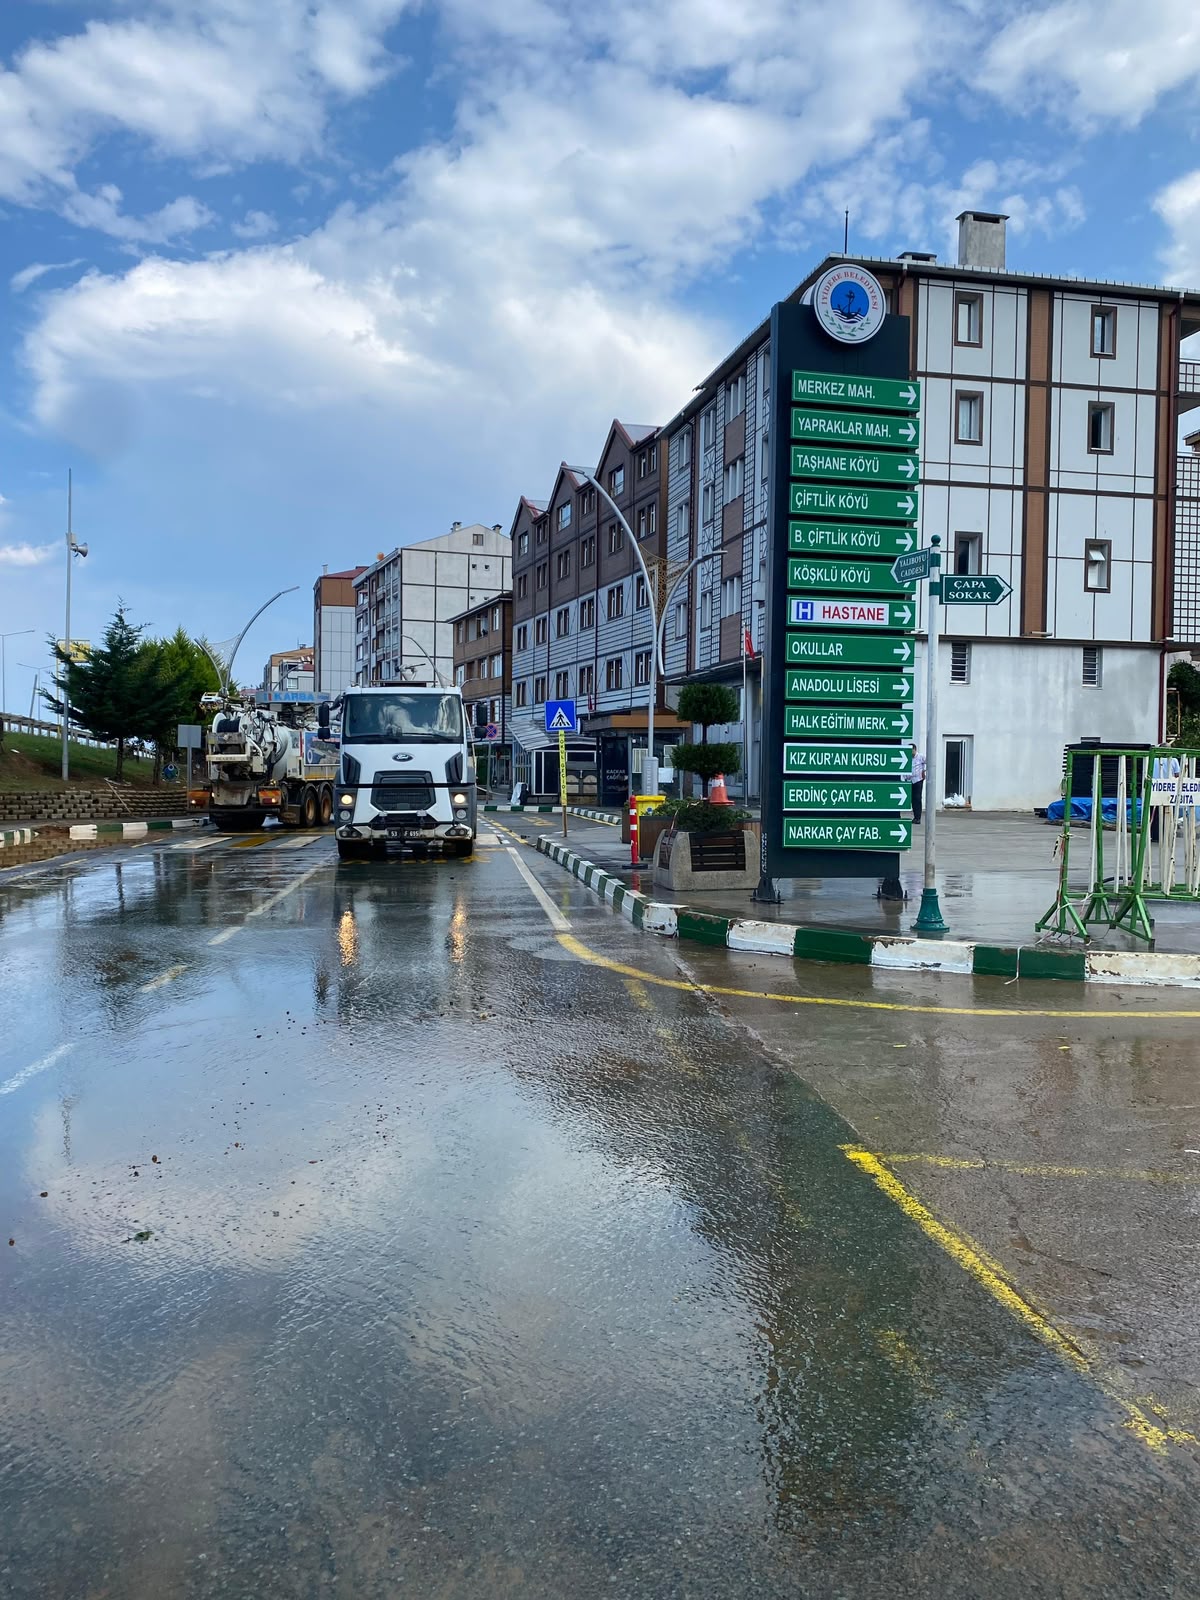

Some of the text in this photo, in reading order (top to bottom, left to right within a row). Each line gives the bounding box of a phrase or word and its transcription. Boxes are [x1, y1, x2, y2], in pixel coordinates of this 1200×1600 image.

[798, 379, 875, 399] MERKEZ MAH.
[798, 416, 891, 438] YAPRAKLAR MAH.
[796, 454, 879, 473] TAŞHANE KÖYÜ
[795, 489, 868, 509] ÇİFTLİK KÖYÜ
[794, 527, 880, 547] B. ÇİFTLİK KÖYÜ
[793, 564, 870, 584] KÖŞKLÜ KÖYÜ
[953, 580, 986, 589] ÇAPA
[948, 591, 991, 599] SOKAK
[822, 605, 885, 621] HASTANE
[791, 641, 843, 656] OKULLAR
[791, 677, 880, 693] ANADOLU LİSESİ
[791, 713, 889, 731] HALK EĞİTİM MERK.
[789, 751, 806, 765] KIZ
[851, 753, 887, 767] KURSU
[1151, 781, 1176, 792] YİDERE
[789, 786, 877, 805] ERDİNÇ ÇAY FAB.
[789, 826, 882, 842] NARKAR ÇAY FAB.
